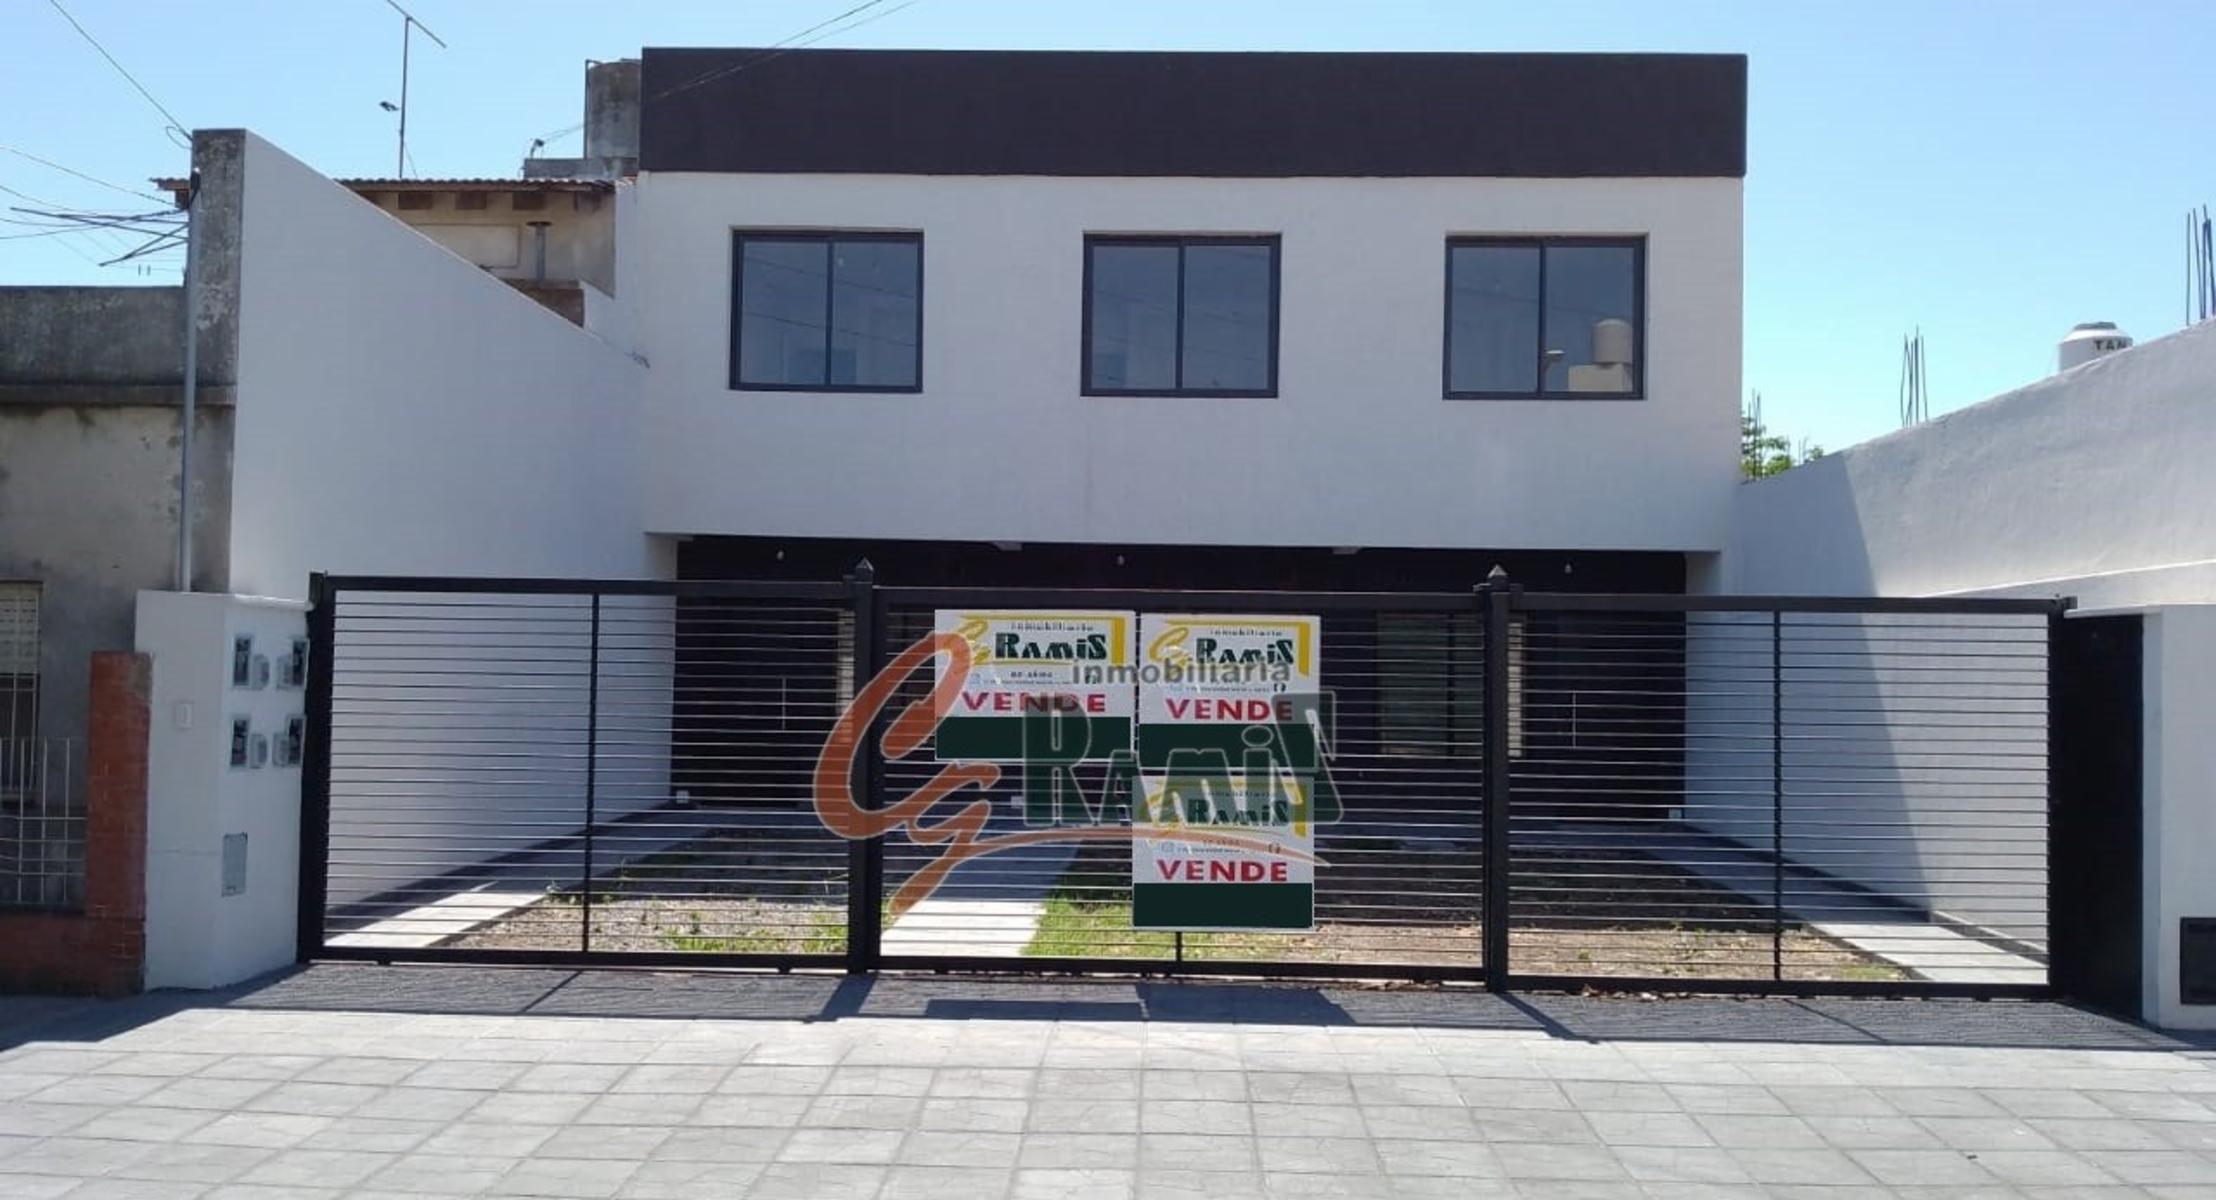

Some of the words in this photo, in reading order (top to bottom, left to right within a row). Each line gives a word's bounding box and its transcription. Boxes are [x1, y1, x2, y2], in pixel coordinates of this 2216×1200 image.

[961, 691, 1106, 712] VENDE
[1166, 699, 1293, 721] VENDE
[1157, 860, 1288, 881] VENDE
